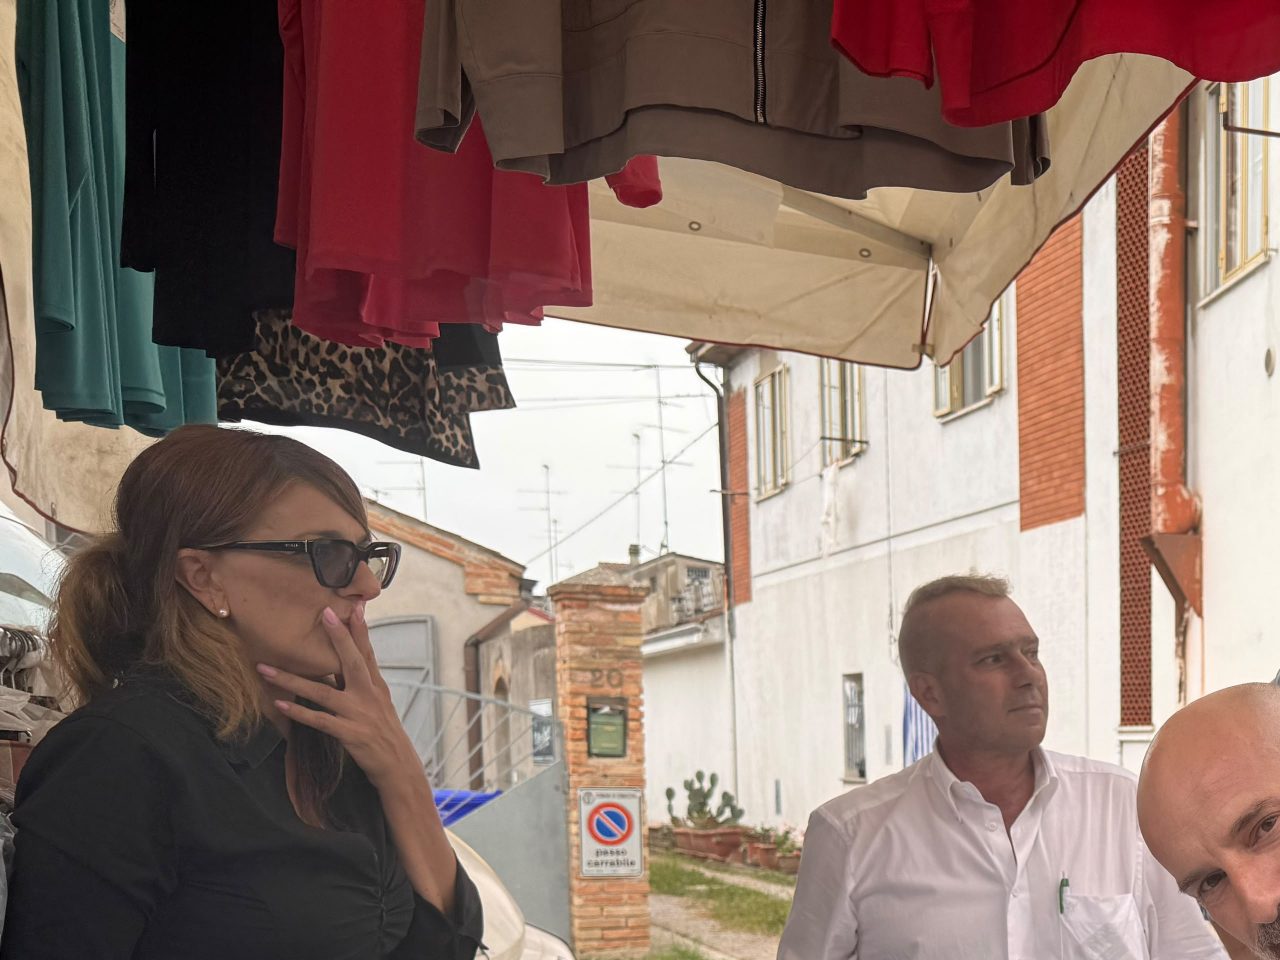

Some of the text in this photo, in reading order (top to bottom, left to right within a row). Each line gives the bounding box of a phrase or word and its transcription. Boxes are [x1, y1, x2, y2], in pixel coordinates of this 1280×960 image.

[591, 668, 624, 688] 20
[596, 848, 628, 858] passo
[588, 858, 636, 868] carrabile
